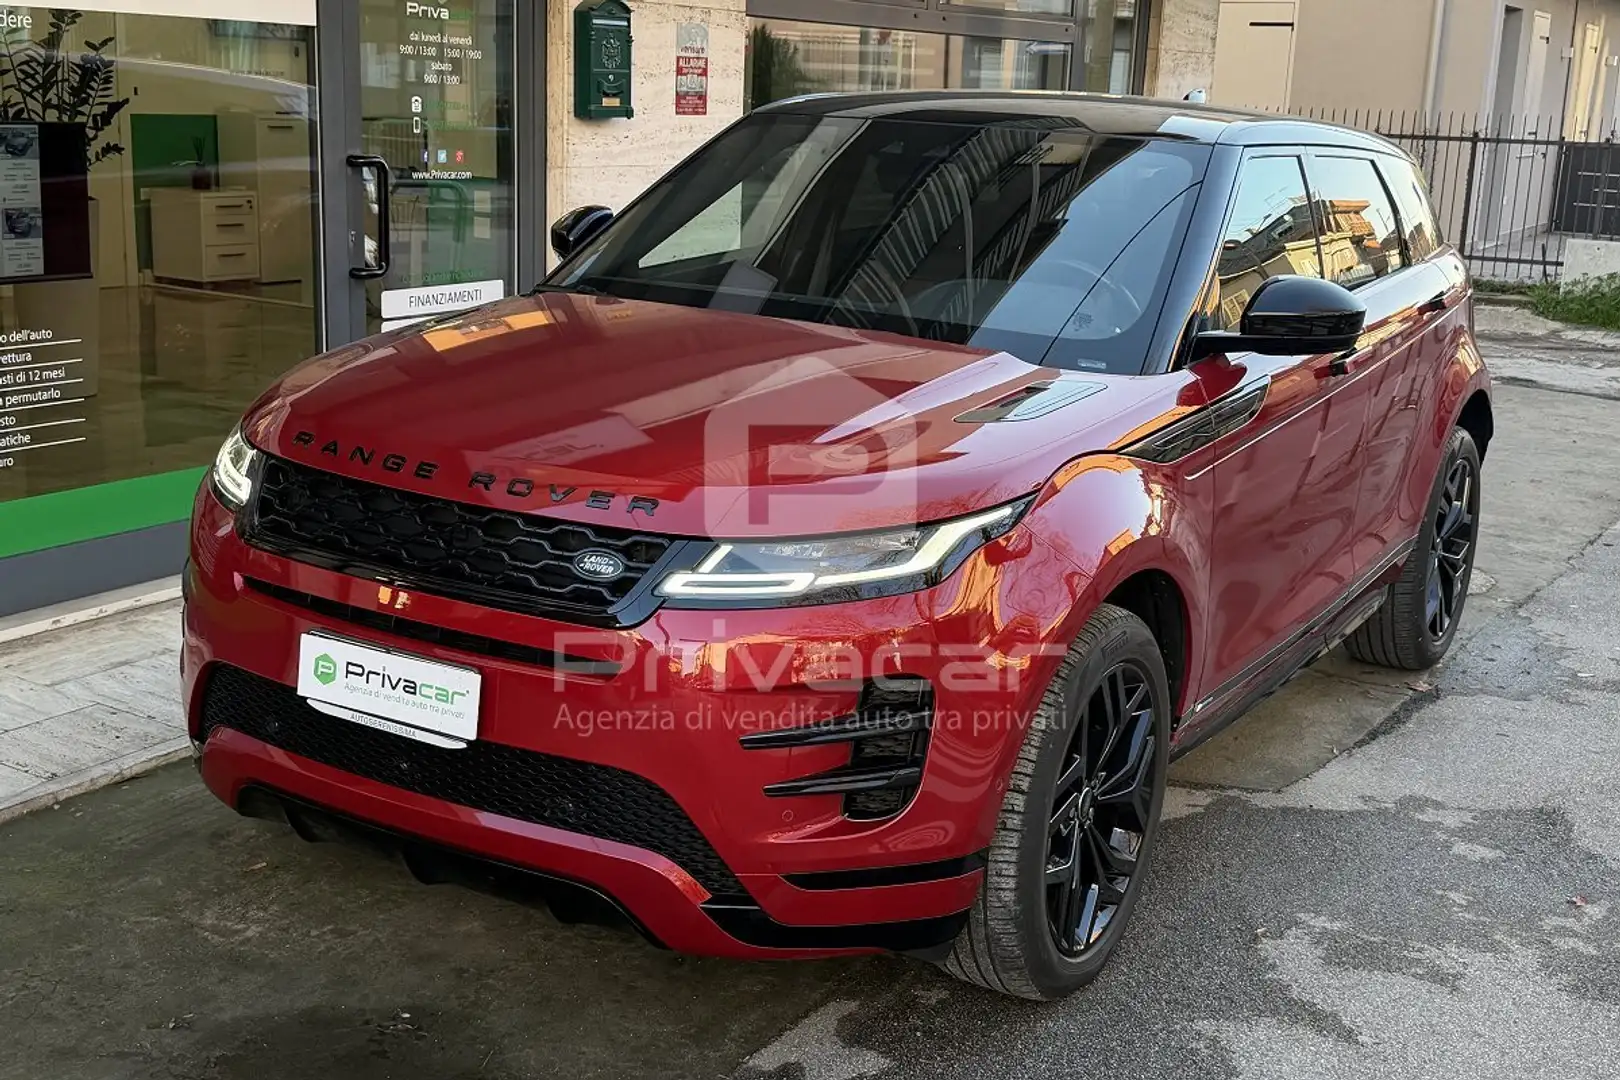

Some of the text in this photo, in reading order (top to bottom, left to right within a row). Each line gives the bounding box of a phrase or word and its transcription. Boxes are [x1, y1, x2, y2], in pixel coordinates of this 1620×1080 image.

[409, 288, 482, 308] FINANZIAMENTI
[0, 353, 32, 364] ettura
[16, 372, 26, 383] di
[28, 370, 40, 381] 12
[42, 366, 66, 379] mesi
[5, 388, 61, 407] permutarlo
[291, 430, 661, 517] RANGE ROVER
[345, 661, 467, 705] Privacar
